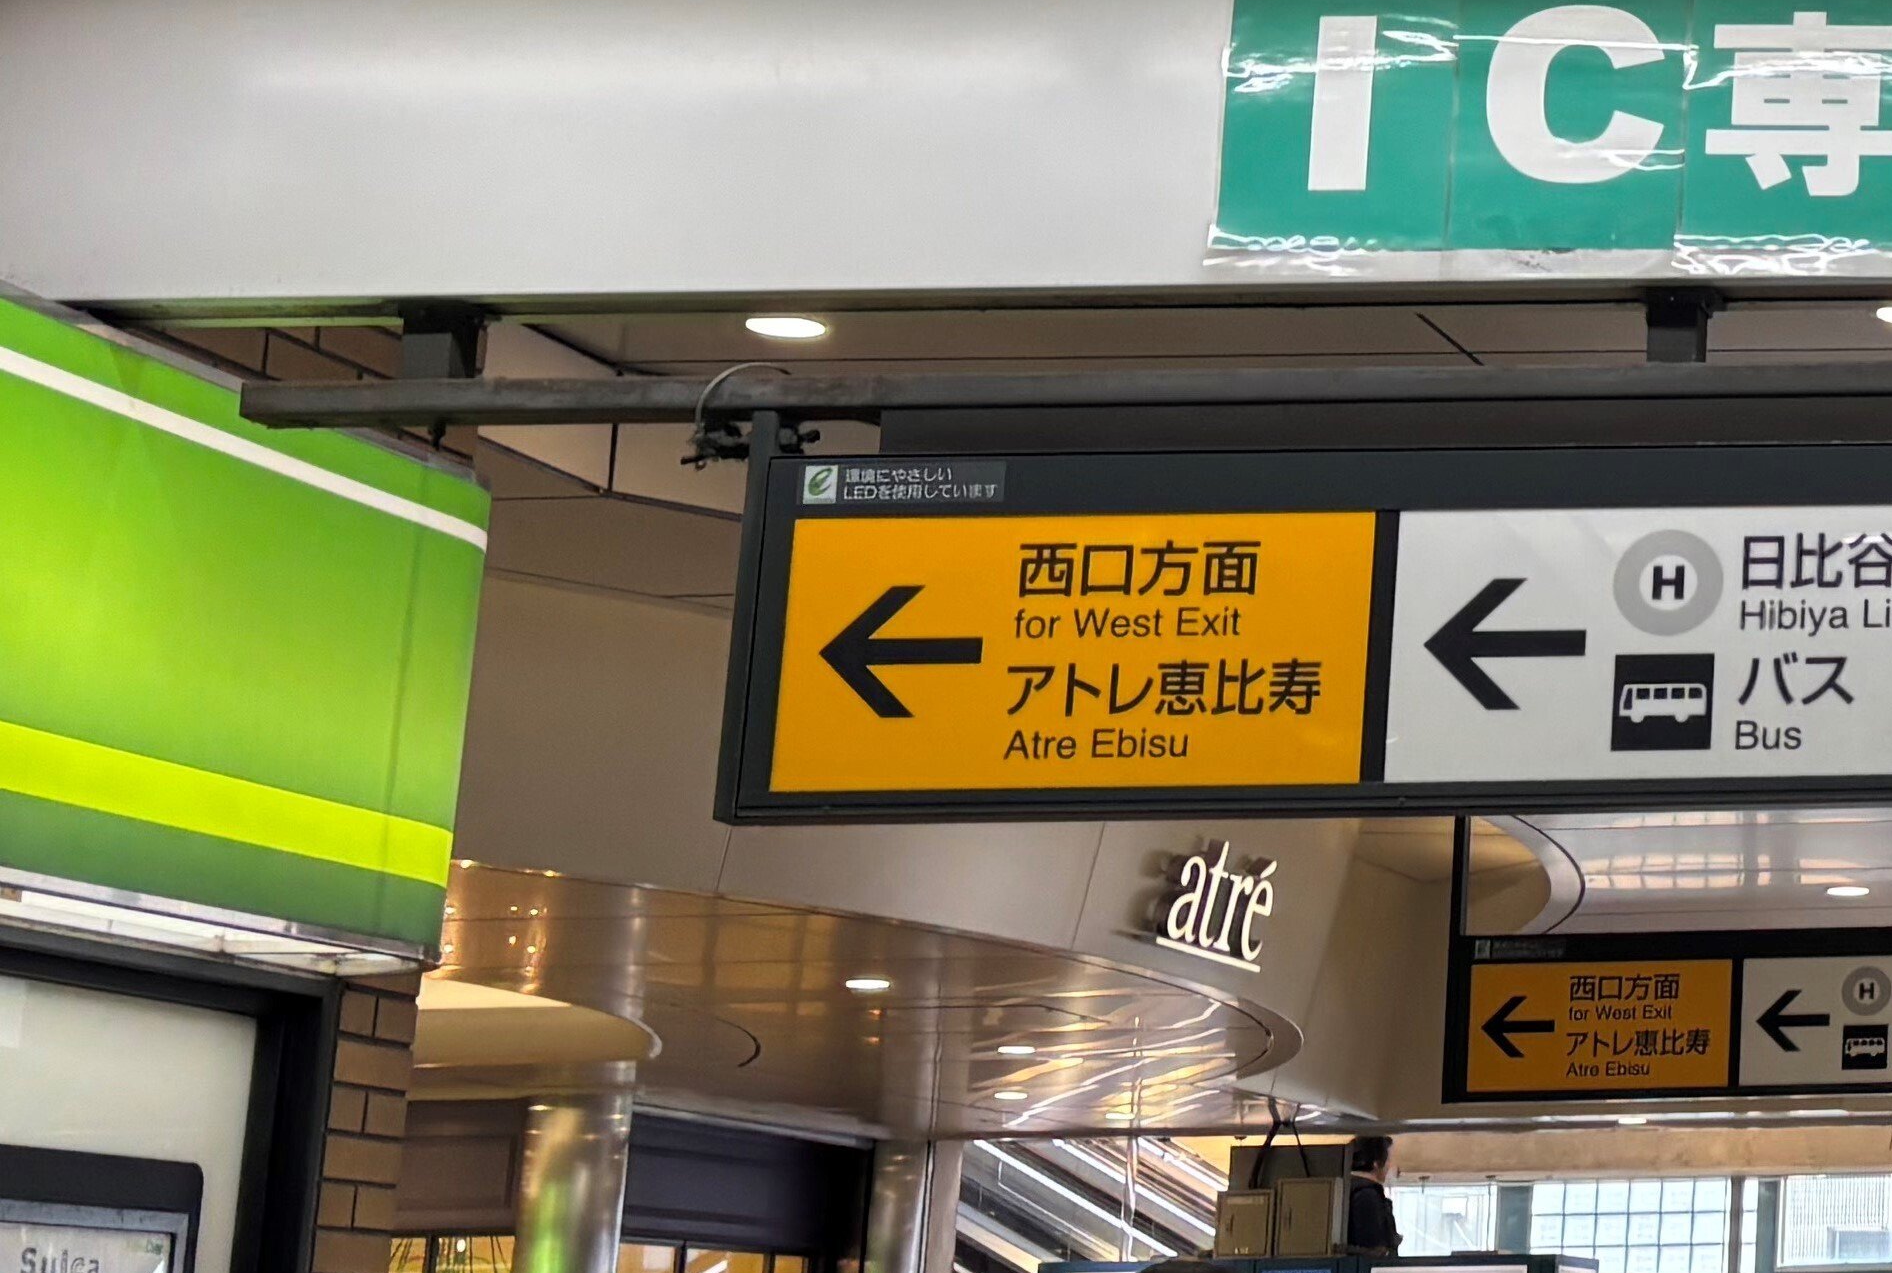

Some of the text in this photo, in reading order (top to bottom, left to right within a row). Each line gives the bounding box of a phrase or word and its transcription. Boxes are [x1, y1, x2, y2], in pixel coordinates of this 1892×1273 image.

[1017, 541, 1260, 599] 西口方面
[1649, 566, 1682, 600] H
[1015, 603, 1241, 641] for West Exit
[1740, 599, 1851, 637] Hibiya
[1003, 657, 1321, 718] アトレ恵比寿
[1737, 655, 1854, 706] バス
[1004, 725, 1189, 760] Atre Ebisu
[1736, 720, 1801, 751] Bus
[1569, 974, 1679, 1001] 西口方面
[1859, 981, 1875, 999] H
[1569, 1003, 1673, 1021] for West Exit
[1566, 1029, 1711, 1058] アトレ恵比寿
[1566, 1060, 1650, 1077] Atre Ebisu
